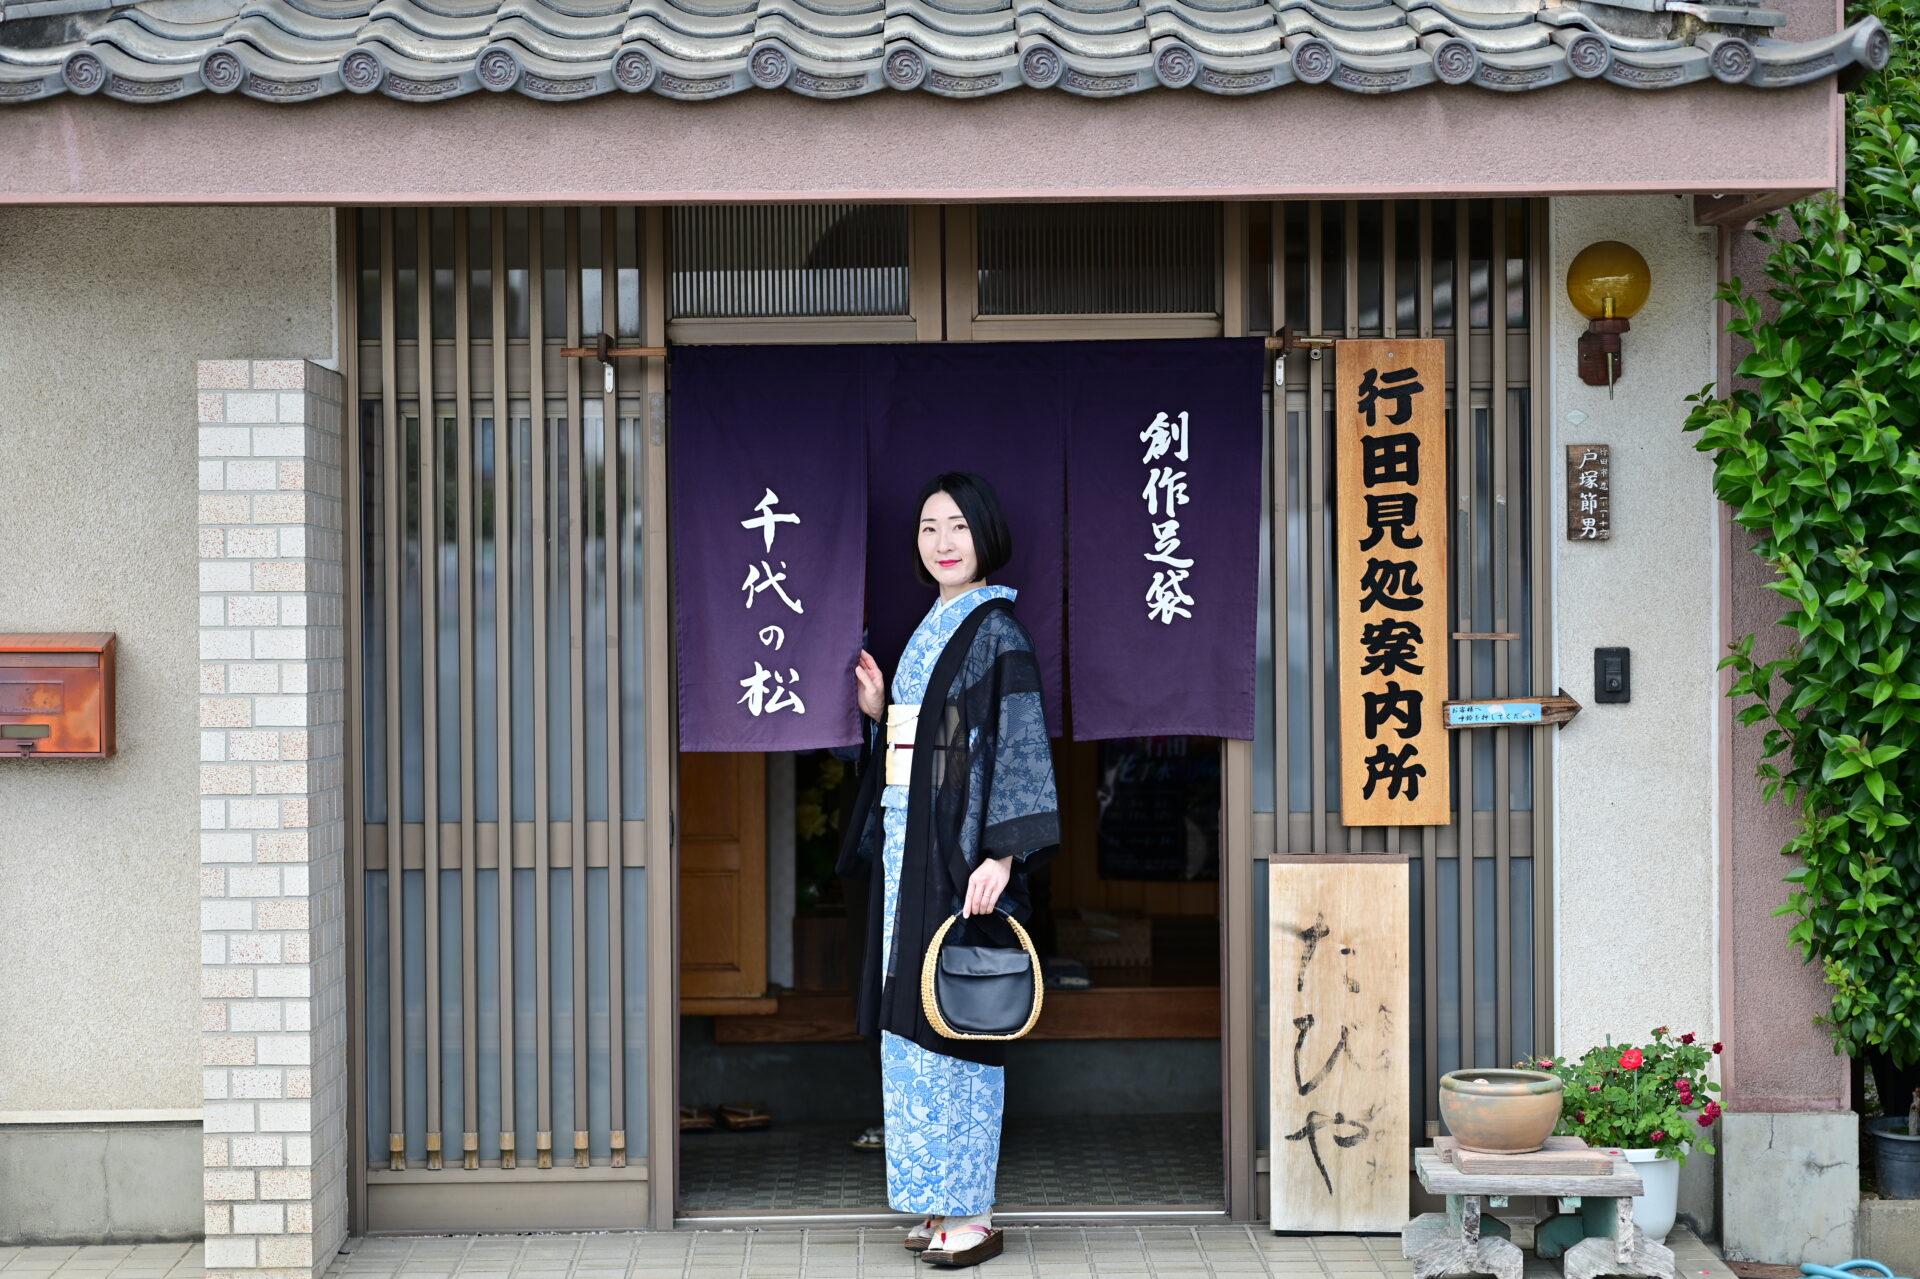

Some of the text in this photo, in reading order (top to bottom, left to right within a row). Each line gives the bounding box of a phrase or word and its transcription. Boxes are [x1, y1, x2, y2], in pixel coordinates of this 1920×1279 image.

[736, 488, 806, 718] 千代の松
[1139, 410, 1195, 626] 創作足袋
[1358, 366, 1426, 801] 行田見処案内所
